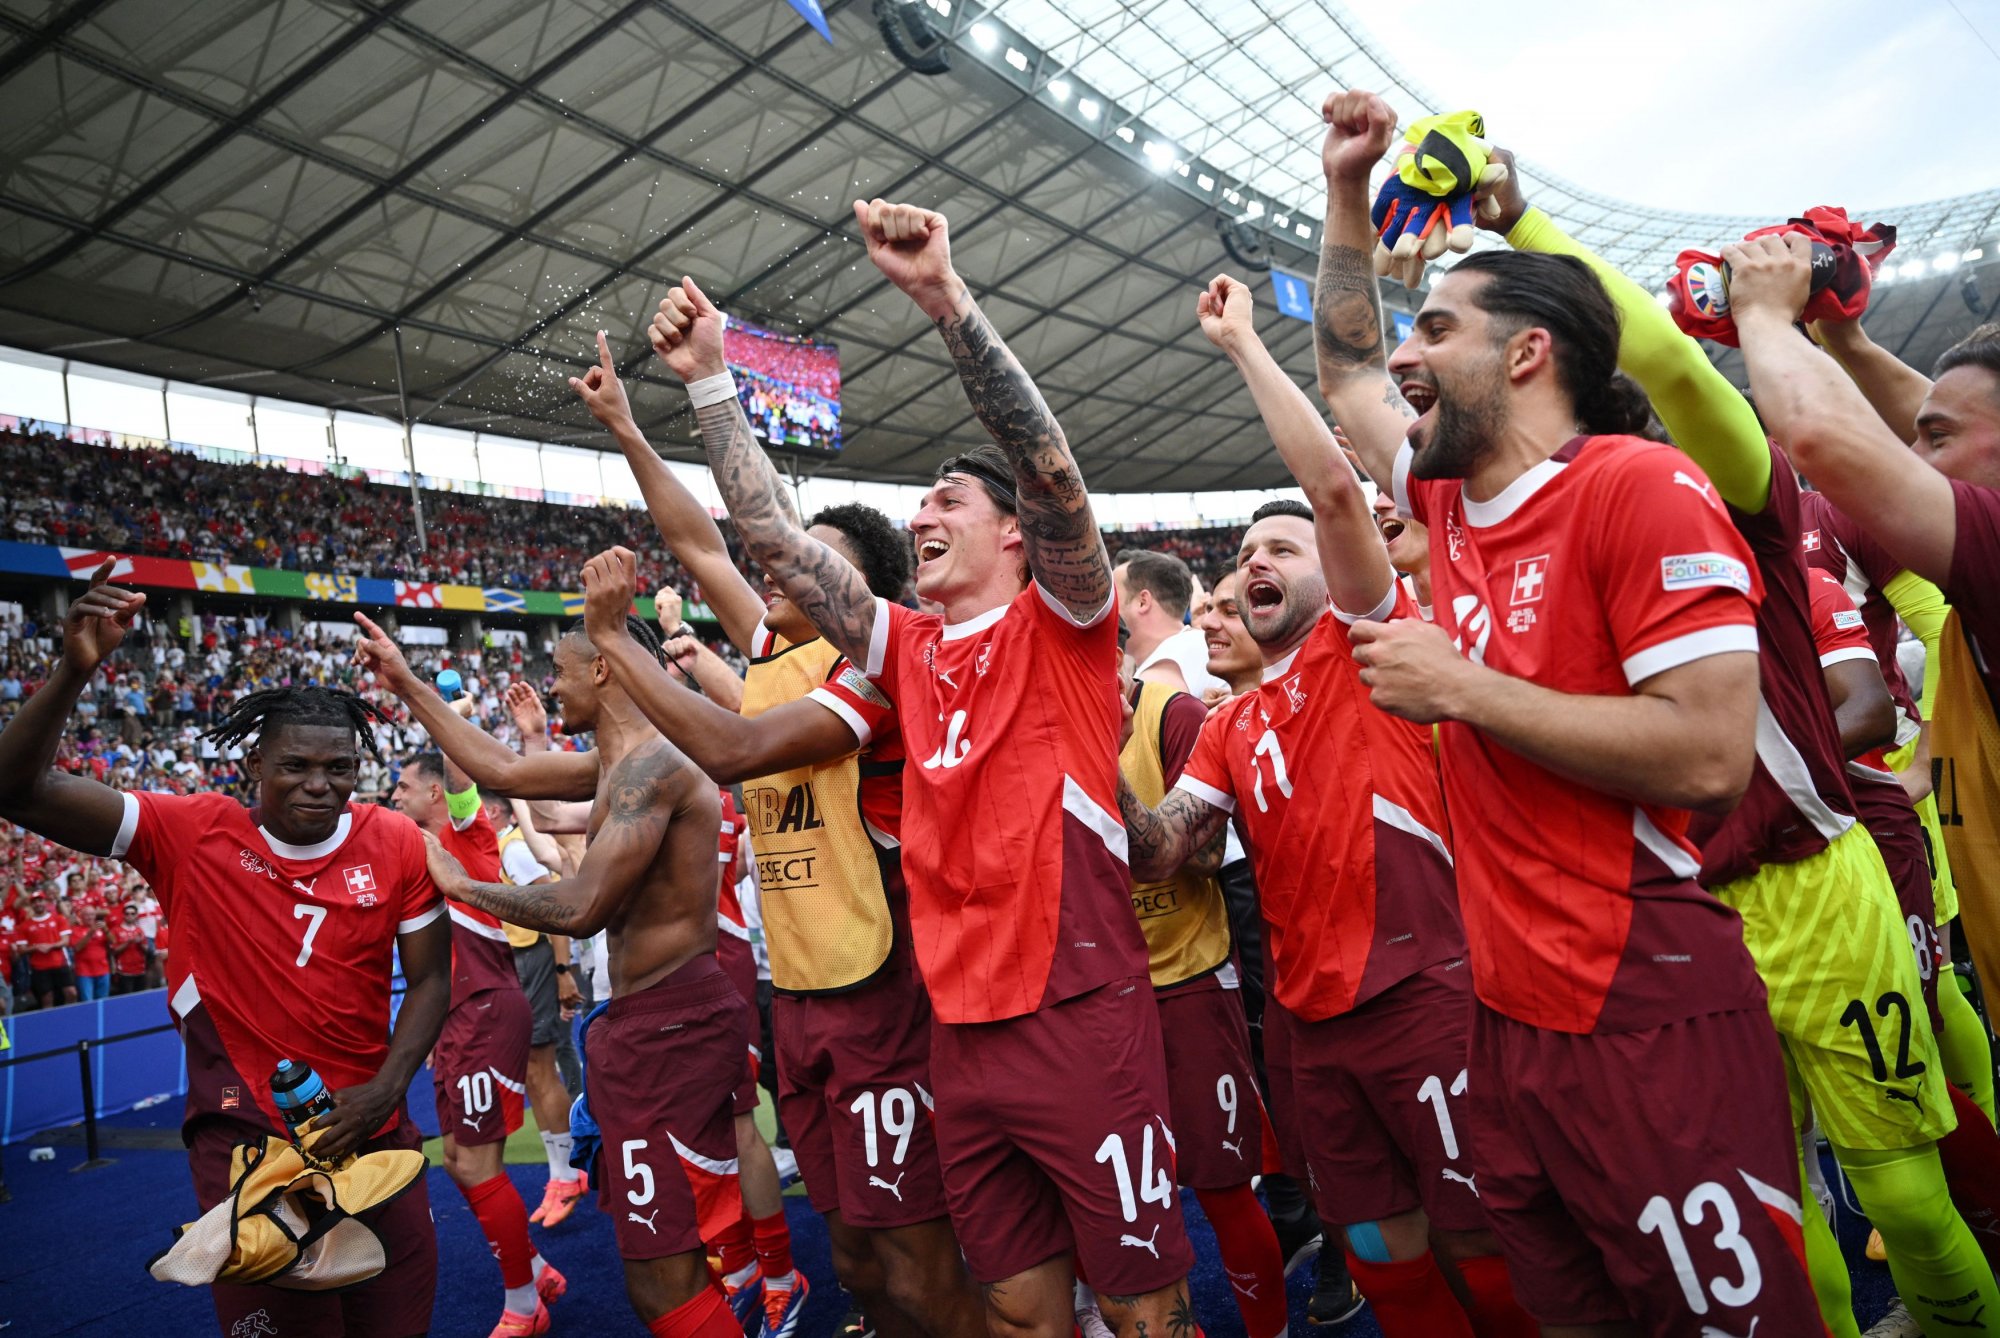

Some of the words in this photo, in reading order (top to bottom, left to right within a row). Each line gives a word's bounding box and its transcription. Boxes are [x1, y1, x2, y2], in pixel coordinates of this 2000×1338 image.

[294, 903, 328, 967] 7
[1906, 914, 1932, 981] 8
[1839, 991, 1926, 1082] 12
[457, 1071, 492, 1116] 10
[850, 1087, 916, 1167] 19
[1216, 1074, 1237, 1134] 9
[622, 1139, 655, 1206] 5
[1095, 1124, 1172, 1223] 14
[1637, 1181, 1762, 1315] 13
